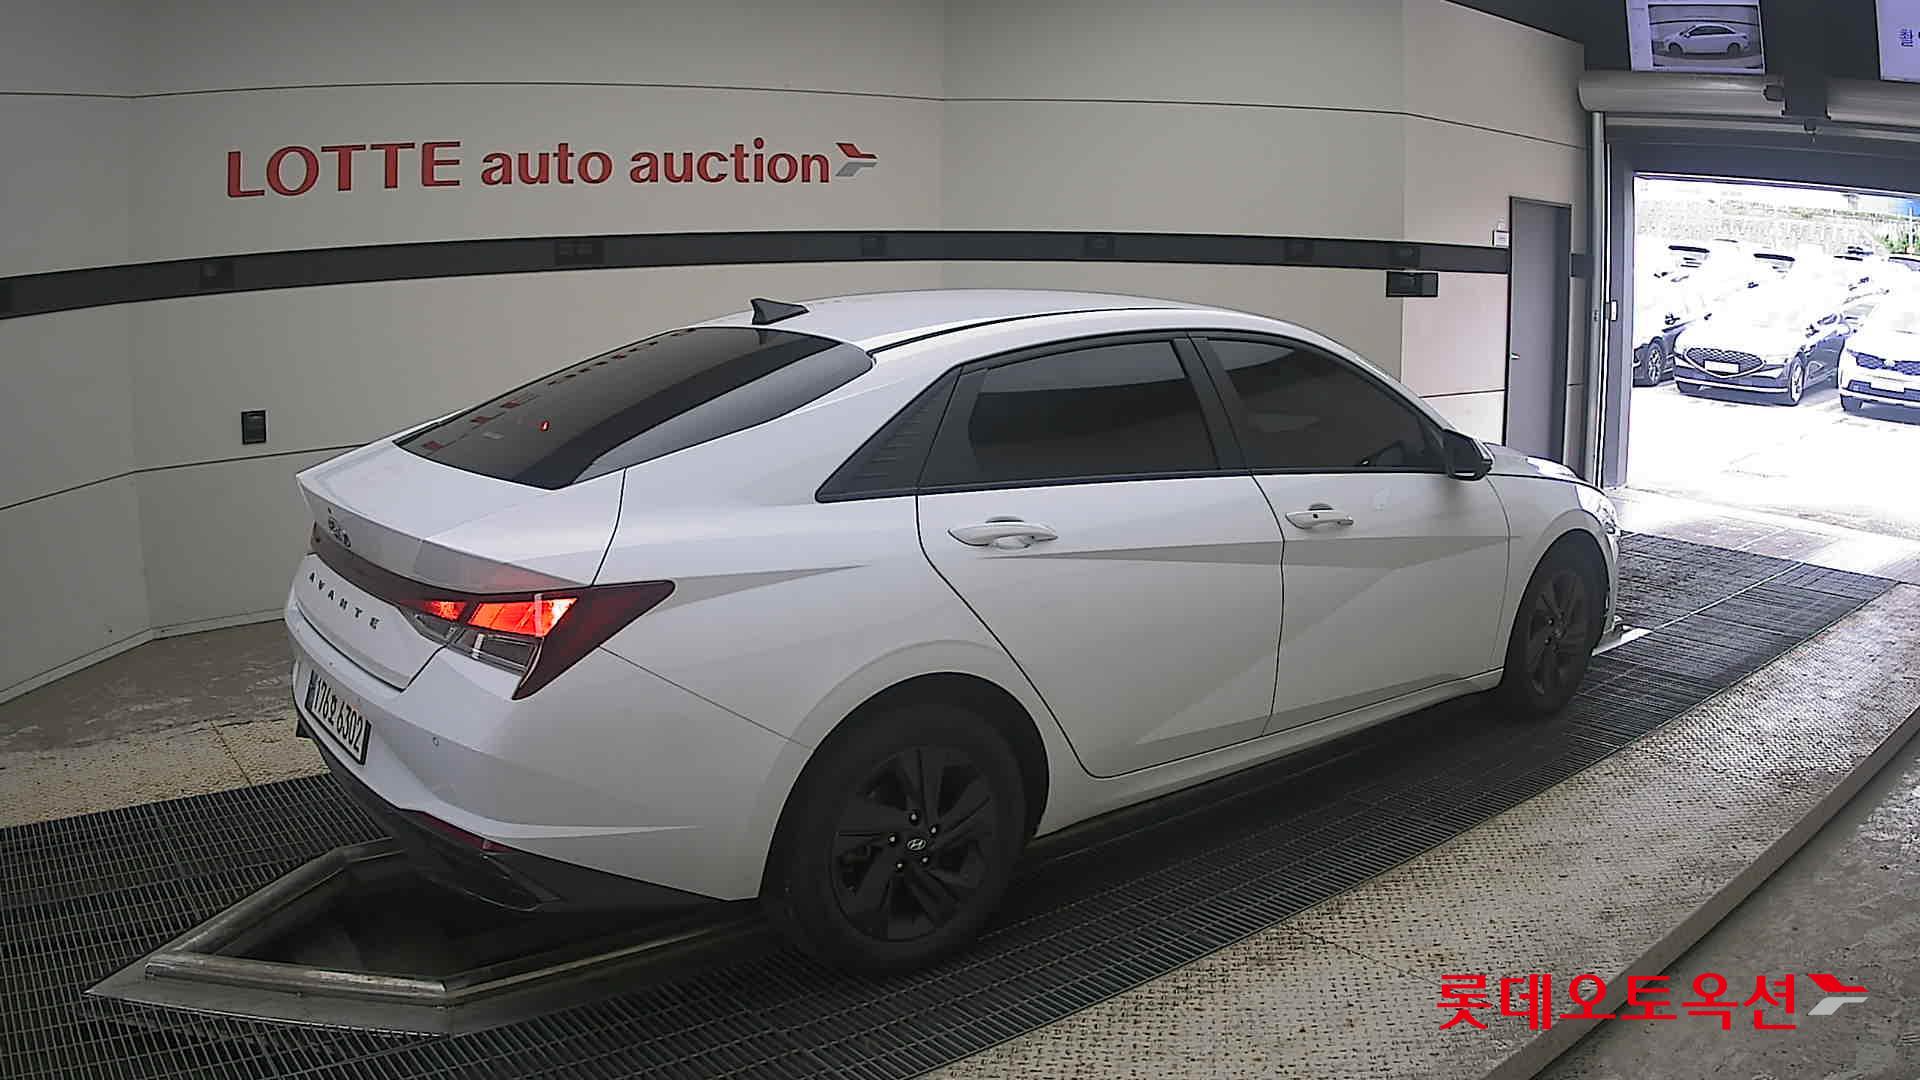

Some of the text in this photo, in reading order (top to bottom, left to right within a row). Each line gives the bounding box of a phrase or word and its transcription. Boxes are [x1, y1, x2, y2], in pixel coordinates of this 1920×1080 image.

[228, 137, 832, 198] LOTTE auto auction
[308, 571, 381, 631] AVANTE
